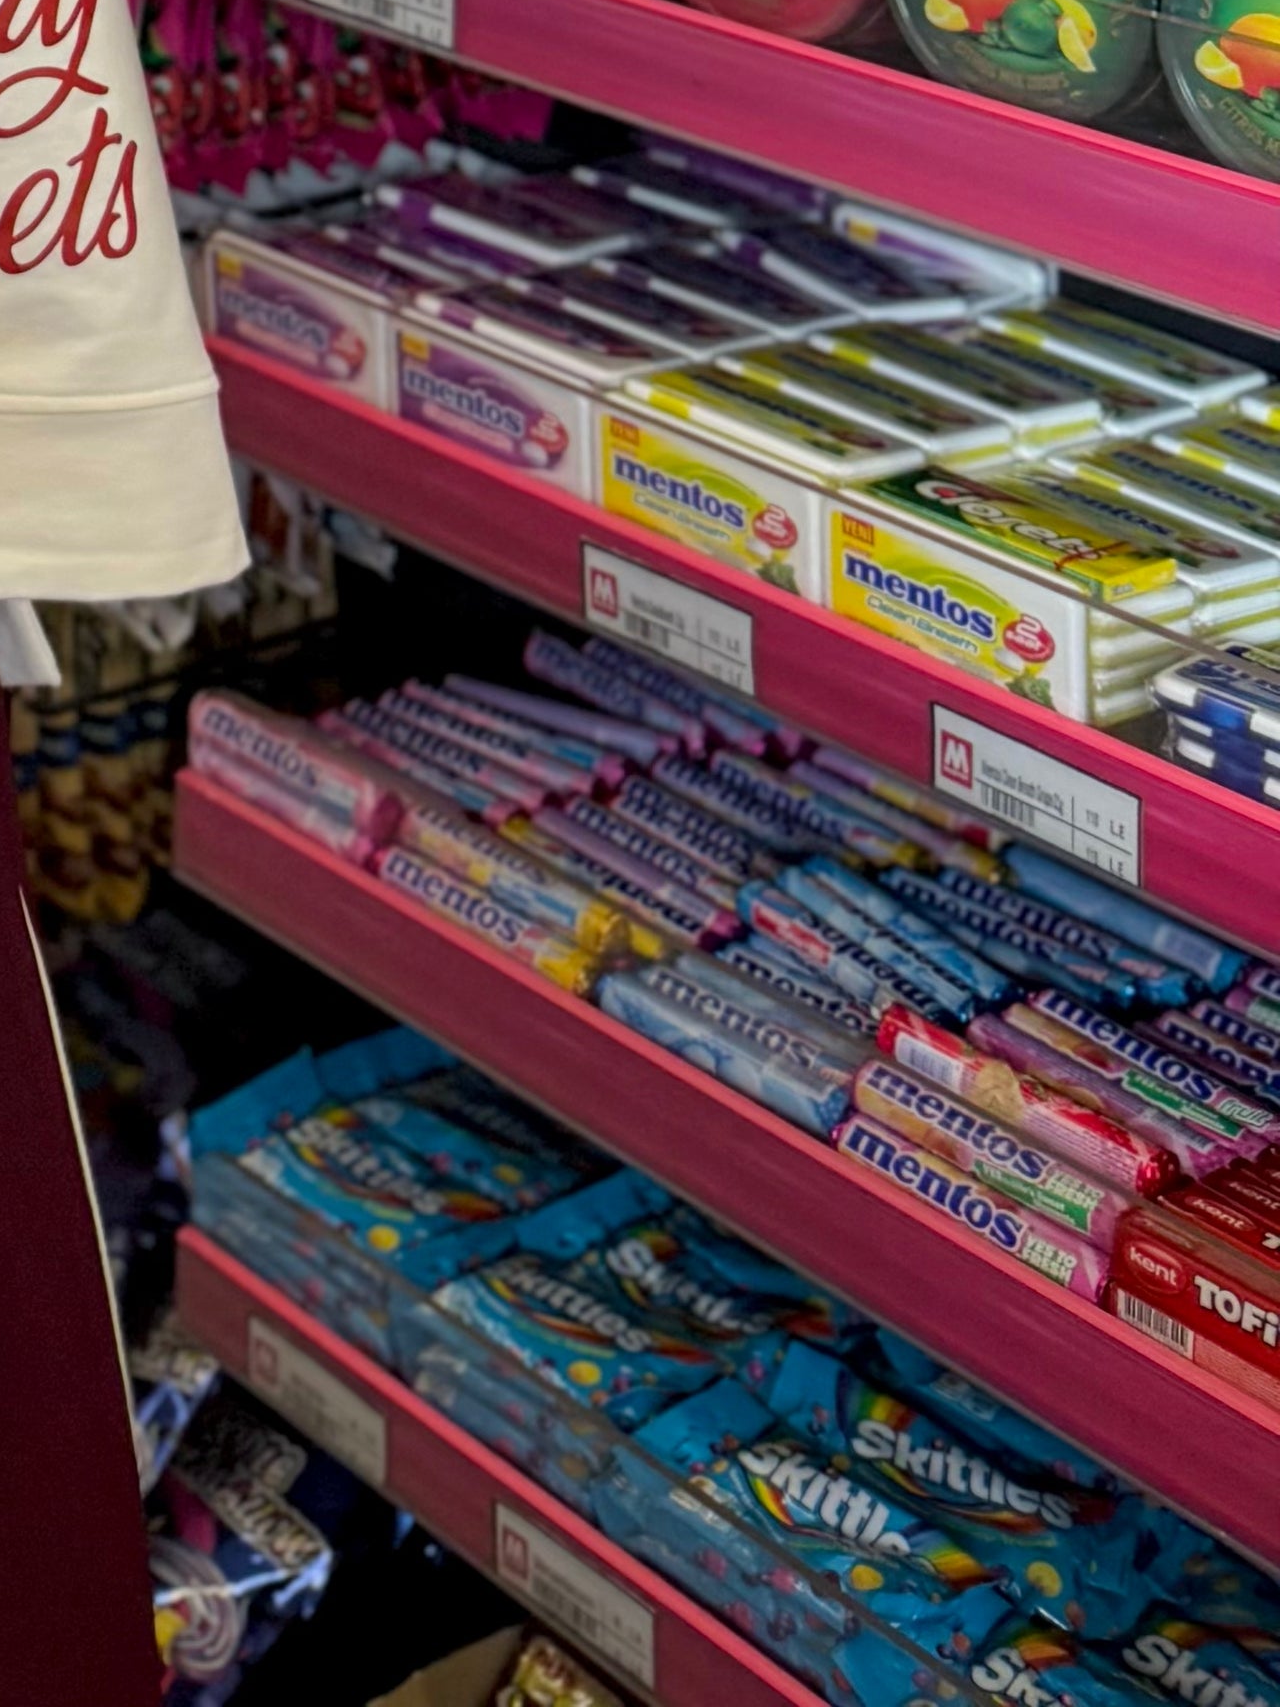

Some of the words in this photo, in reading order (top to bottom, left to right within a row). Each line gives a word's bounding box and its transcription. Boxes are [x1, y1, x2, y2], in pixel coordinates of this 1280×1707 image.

[401, 365, 526, 439] mentos
[612, 452, 746, 530] mentos
[843, 552, 996, 641] mentos
[201, 704, 320, 788] mentos
[383, 848, 527, 947] mentos
[648, 964, 822, 1072] mentos
[1043, 989, 1217, 1103] mentos
[868, 1062, 1051, 1182] mentos
[844, 1122, 1026, 1252] mentos
[1192, 1198, 1246, 1231] kent
[1128, 1245, 1178, 1287] kent
[737, 1440, 912, 1558] Skittle
[850, 1419, 1076, 1530] Skittles
